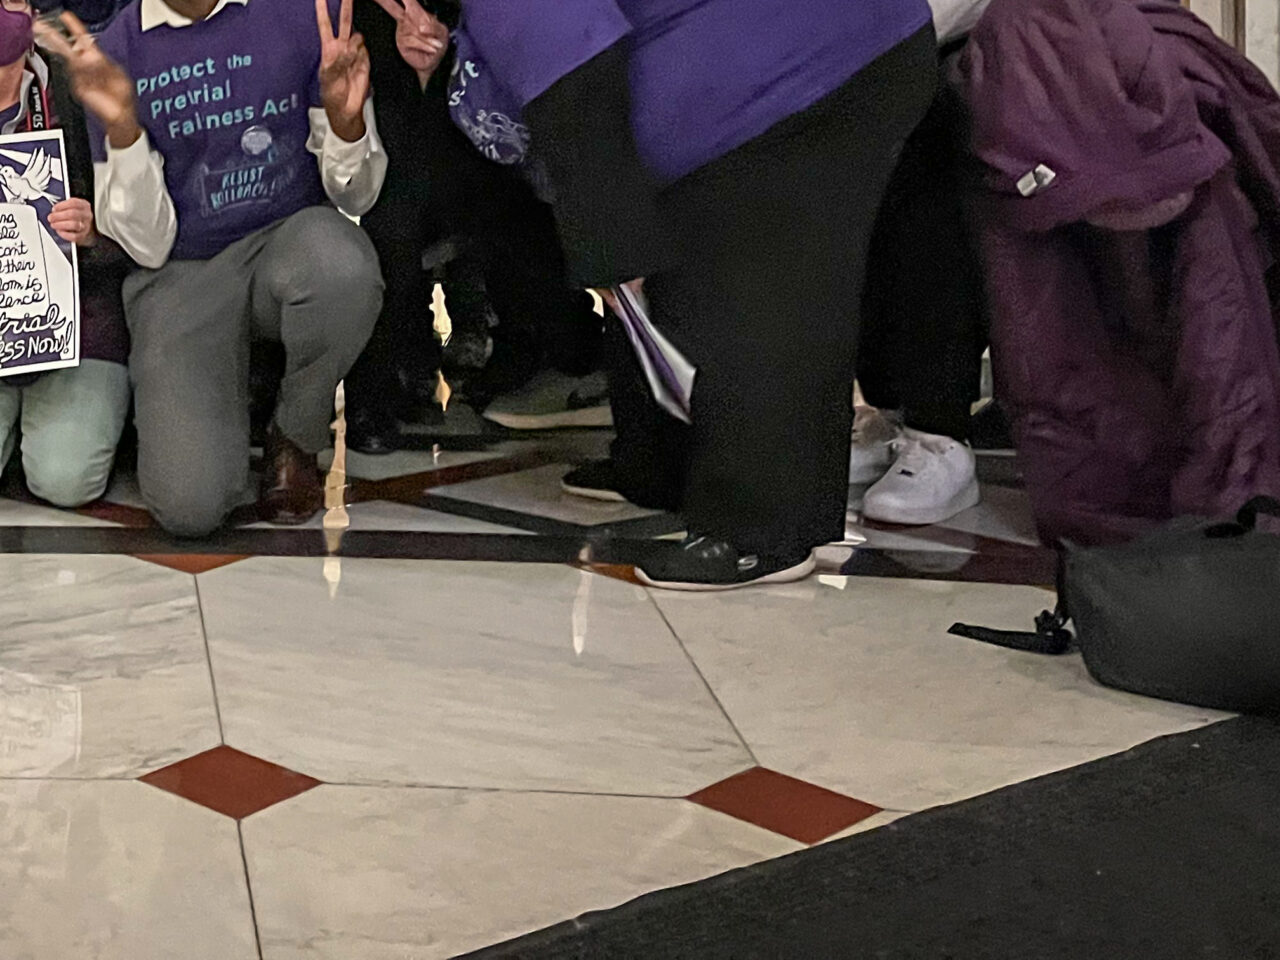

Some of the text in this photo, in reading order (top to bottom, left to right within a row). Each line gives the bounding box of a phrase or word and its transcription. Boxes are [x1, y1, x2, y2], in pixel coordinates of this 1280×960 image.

[136, 54, 252, 97] Protect the
[150, 79, 231, 119] Pretrial
[262, 93, 298, 118] Act
[5, 258, 36, 274] their
[25, 274, 43, 292] is
[26, 321, 73, 359] Now!
